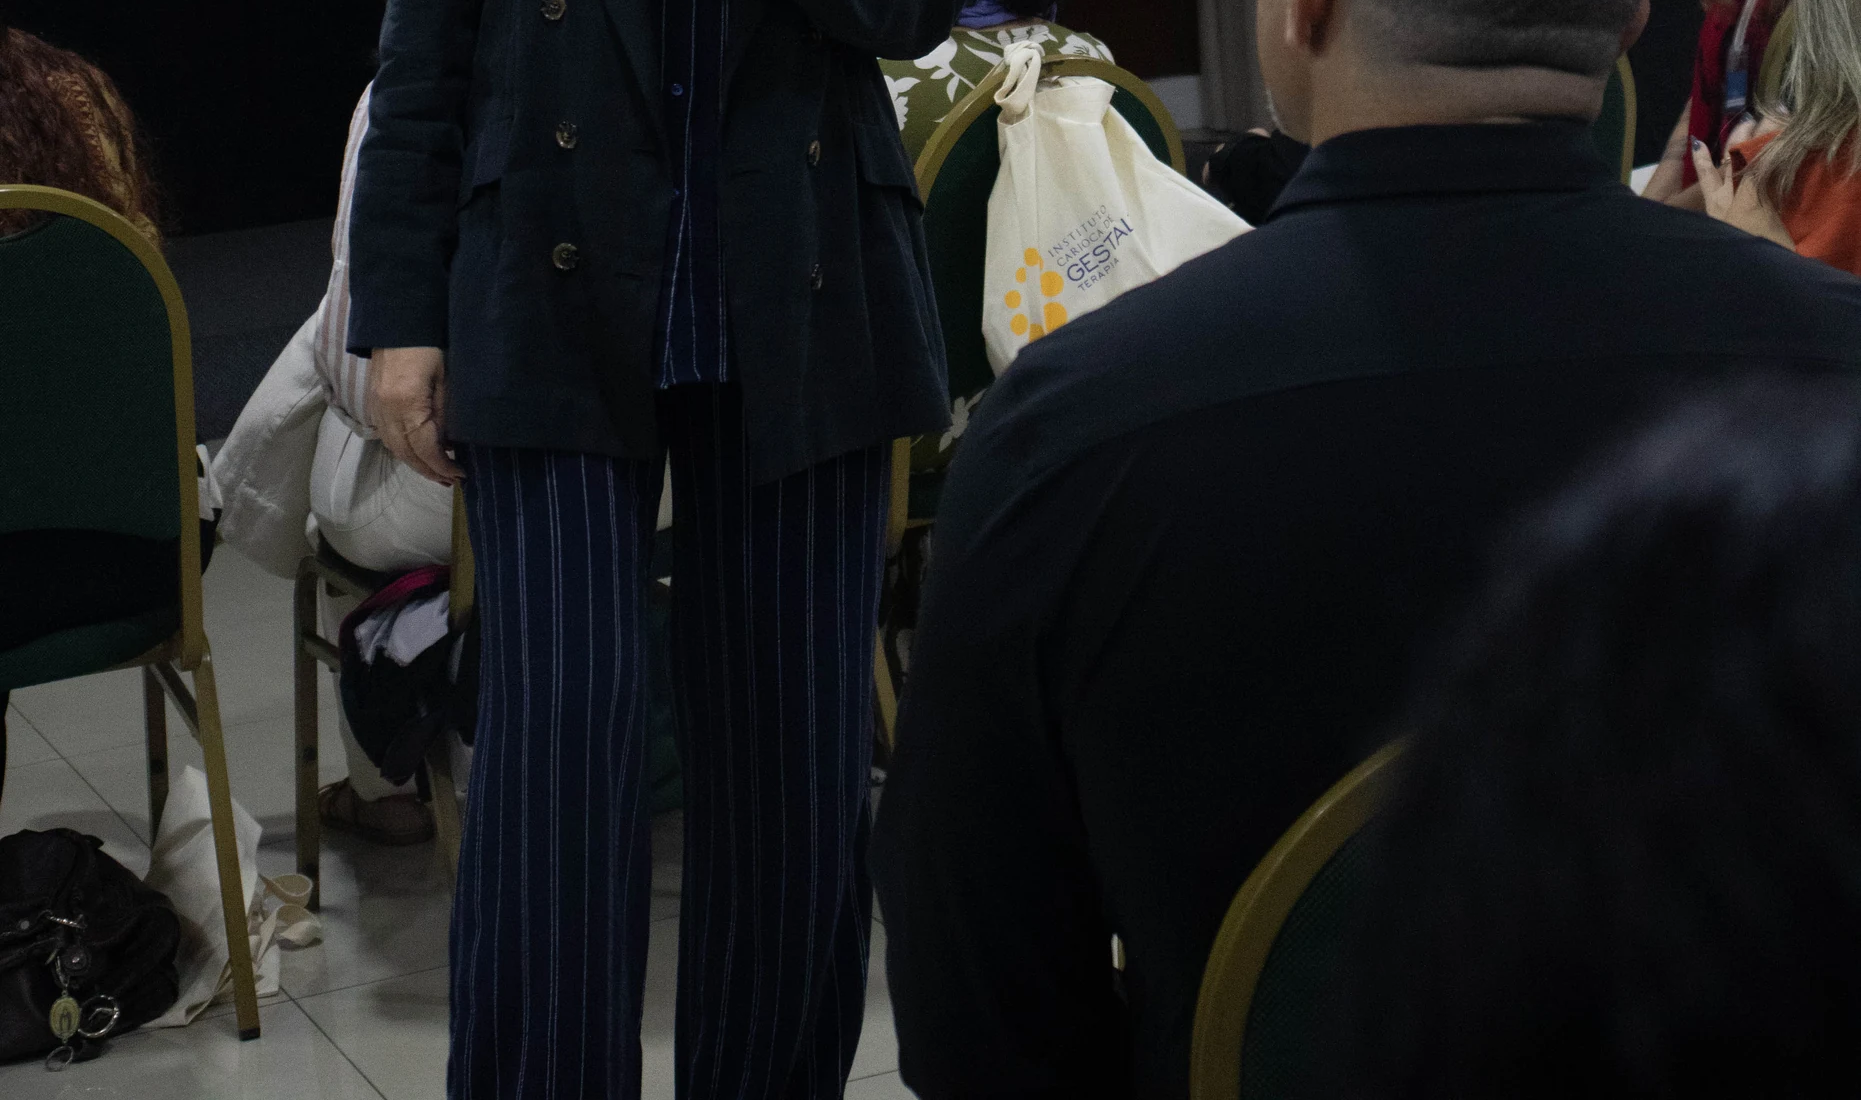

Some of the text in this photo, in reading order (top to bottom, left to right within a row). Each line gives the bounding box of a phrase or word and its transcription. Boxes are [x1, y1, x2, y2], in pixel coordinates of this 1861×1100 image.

[1047, 204, 1107, 258] INSTITUTO
[1056, 228, 1104, 267] CARIOCA
[1066, 216, 1134, 282] GESTAL
[1077, 257, 1120, 292] TERAPIA
